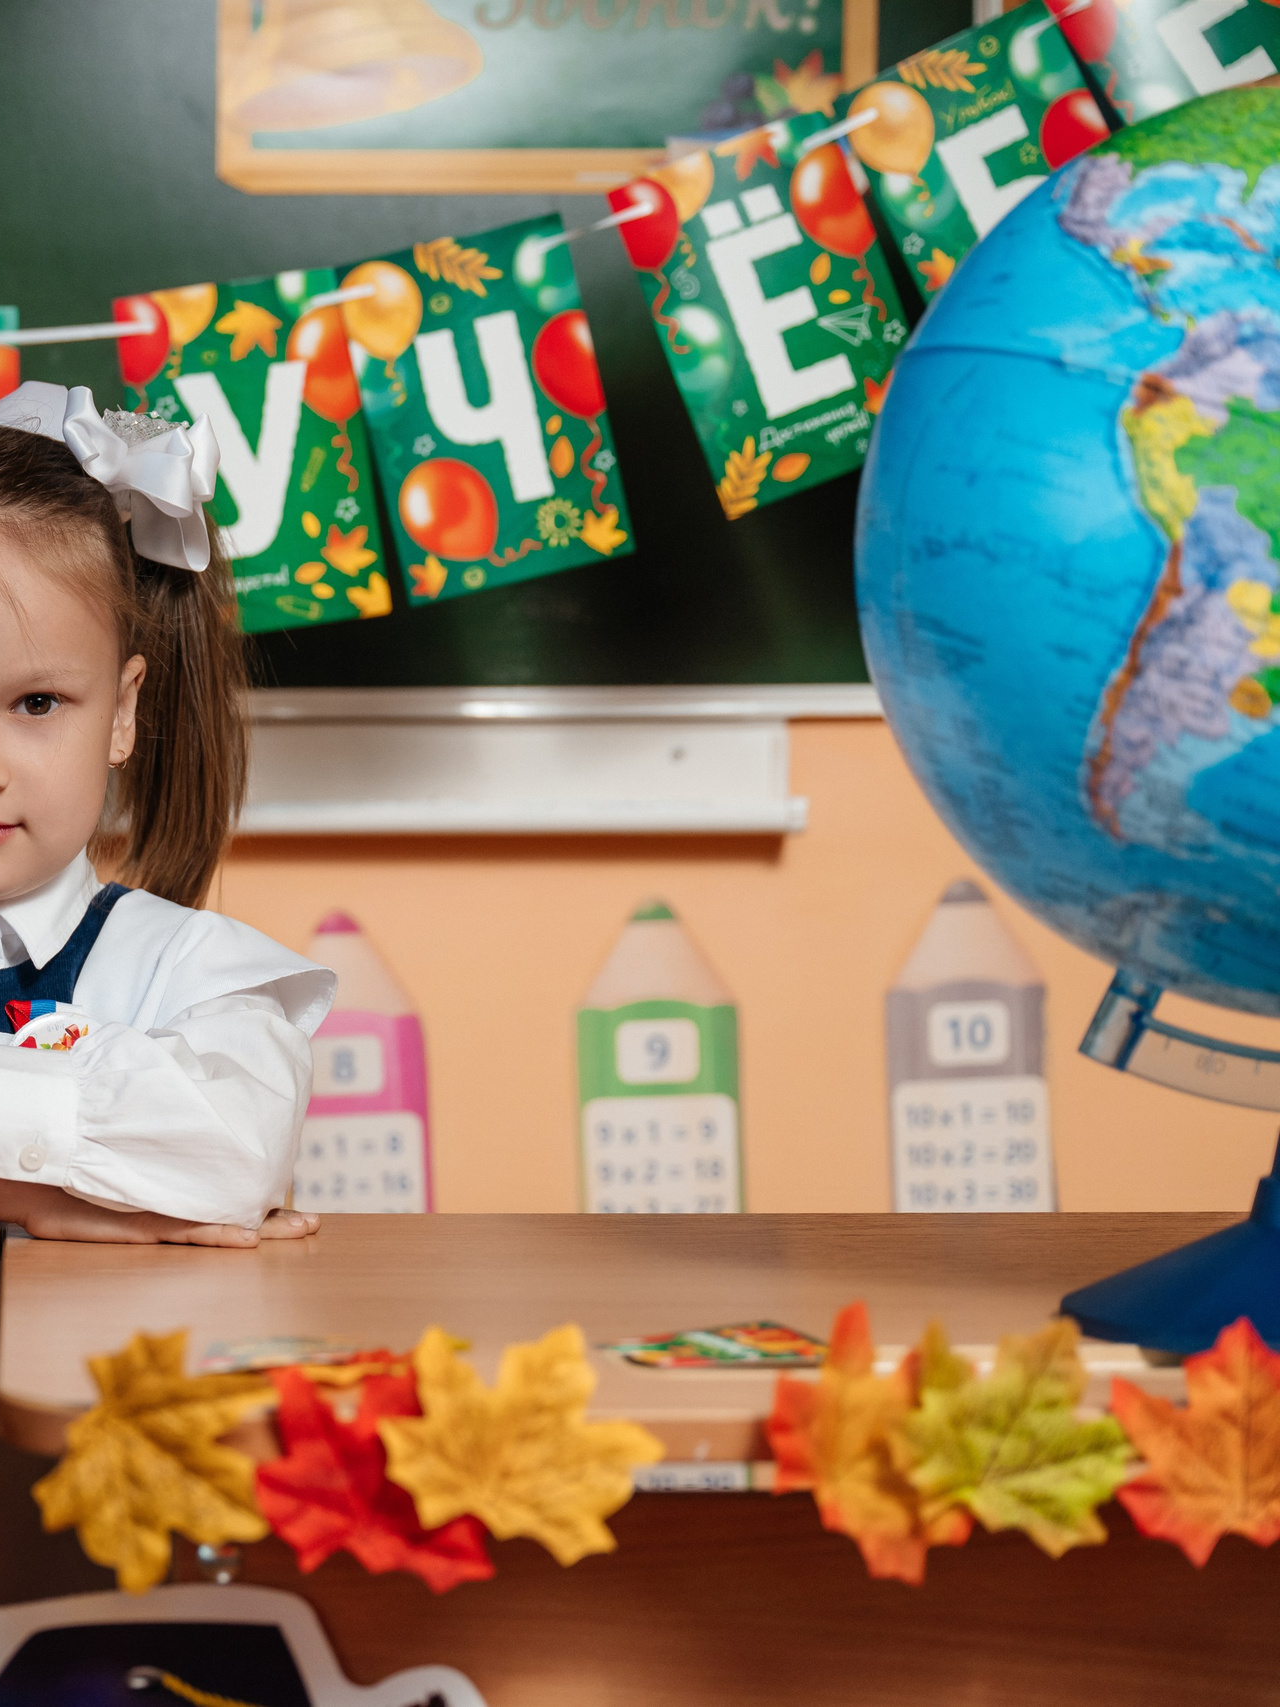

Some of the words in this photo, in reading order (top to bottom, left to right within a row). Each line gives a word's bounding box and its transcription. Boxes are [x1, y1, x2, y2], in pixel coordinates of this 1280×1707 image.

[645, 1031, 671, 1071] 9
[946, 1014, 994, 1051] 10
[332, 1046, 357, 1086] 8
